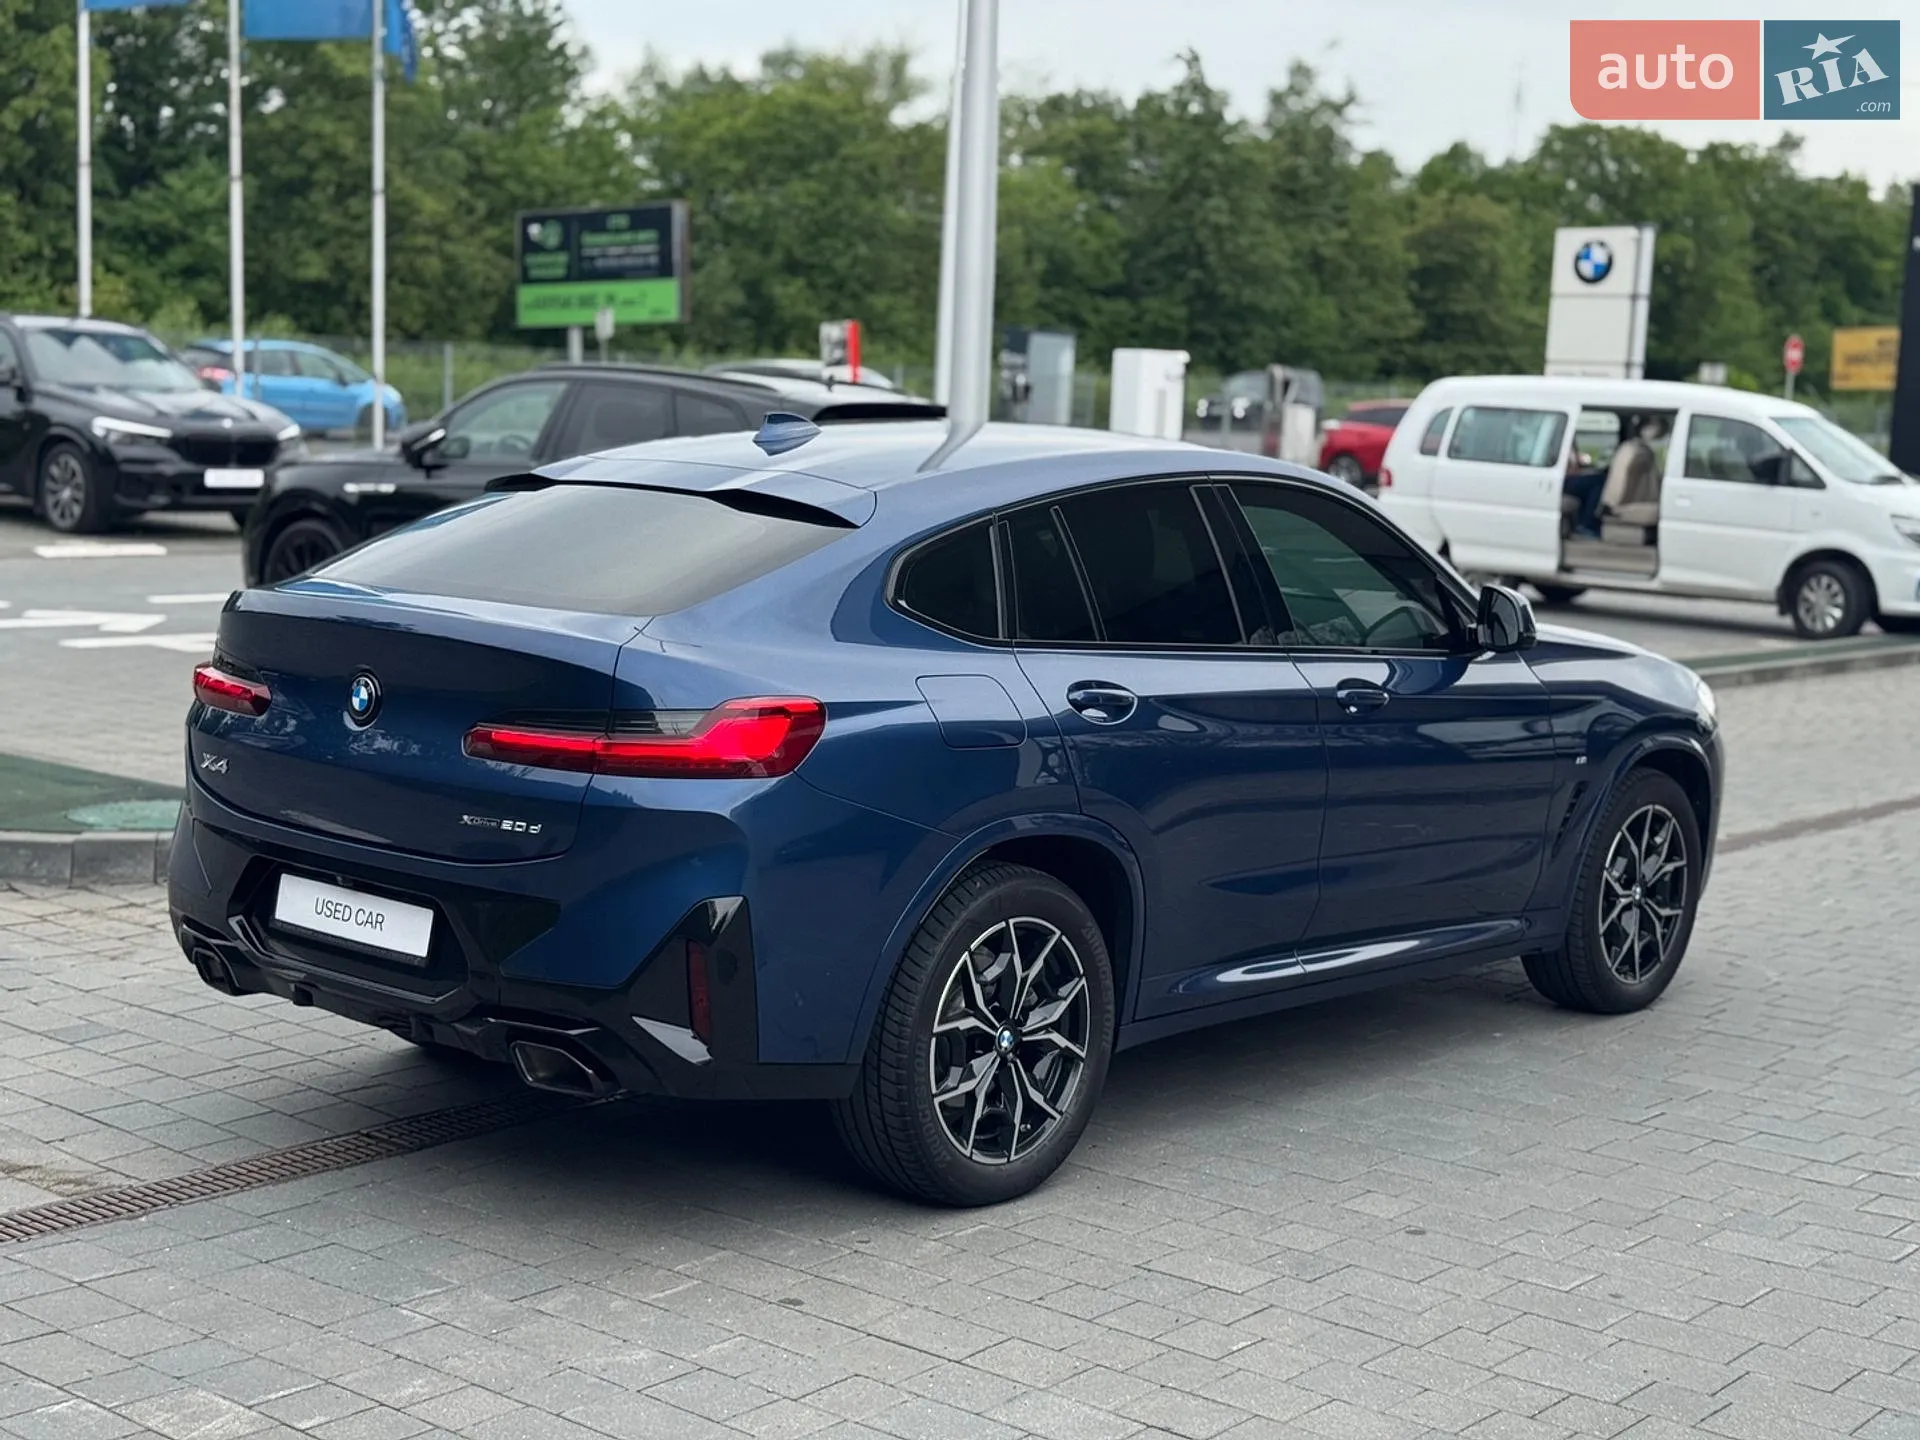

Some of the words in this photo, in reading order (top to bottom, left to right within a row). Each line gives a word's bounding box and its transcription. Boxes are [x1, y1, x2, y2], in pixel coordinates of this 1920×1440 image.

[200, 752, 228, 774] X4
[314, 897, 352, 922] USED
[355, 908, 385, 932] CAR
